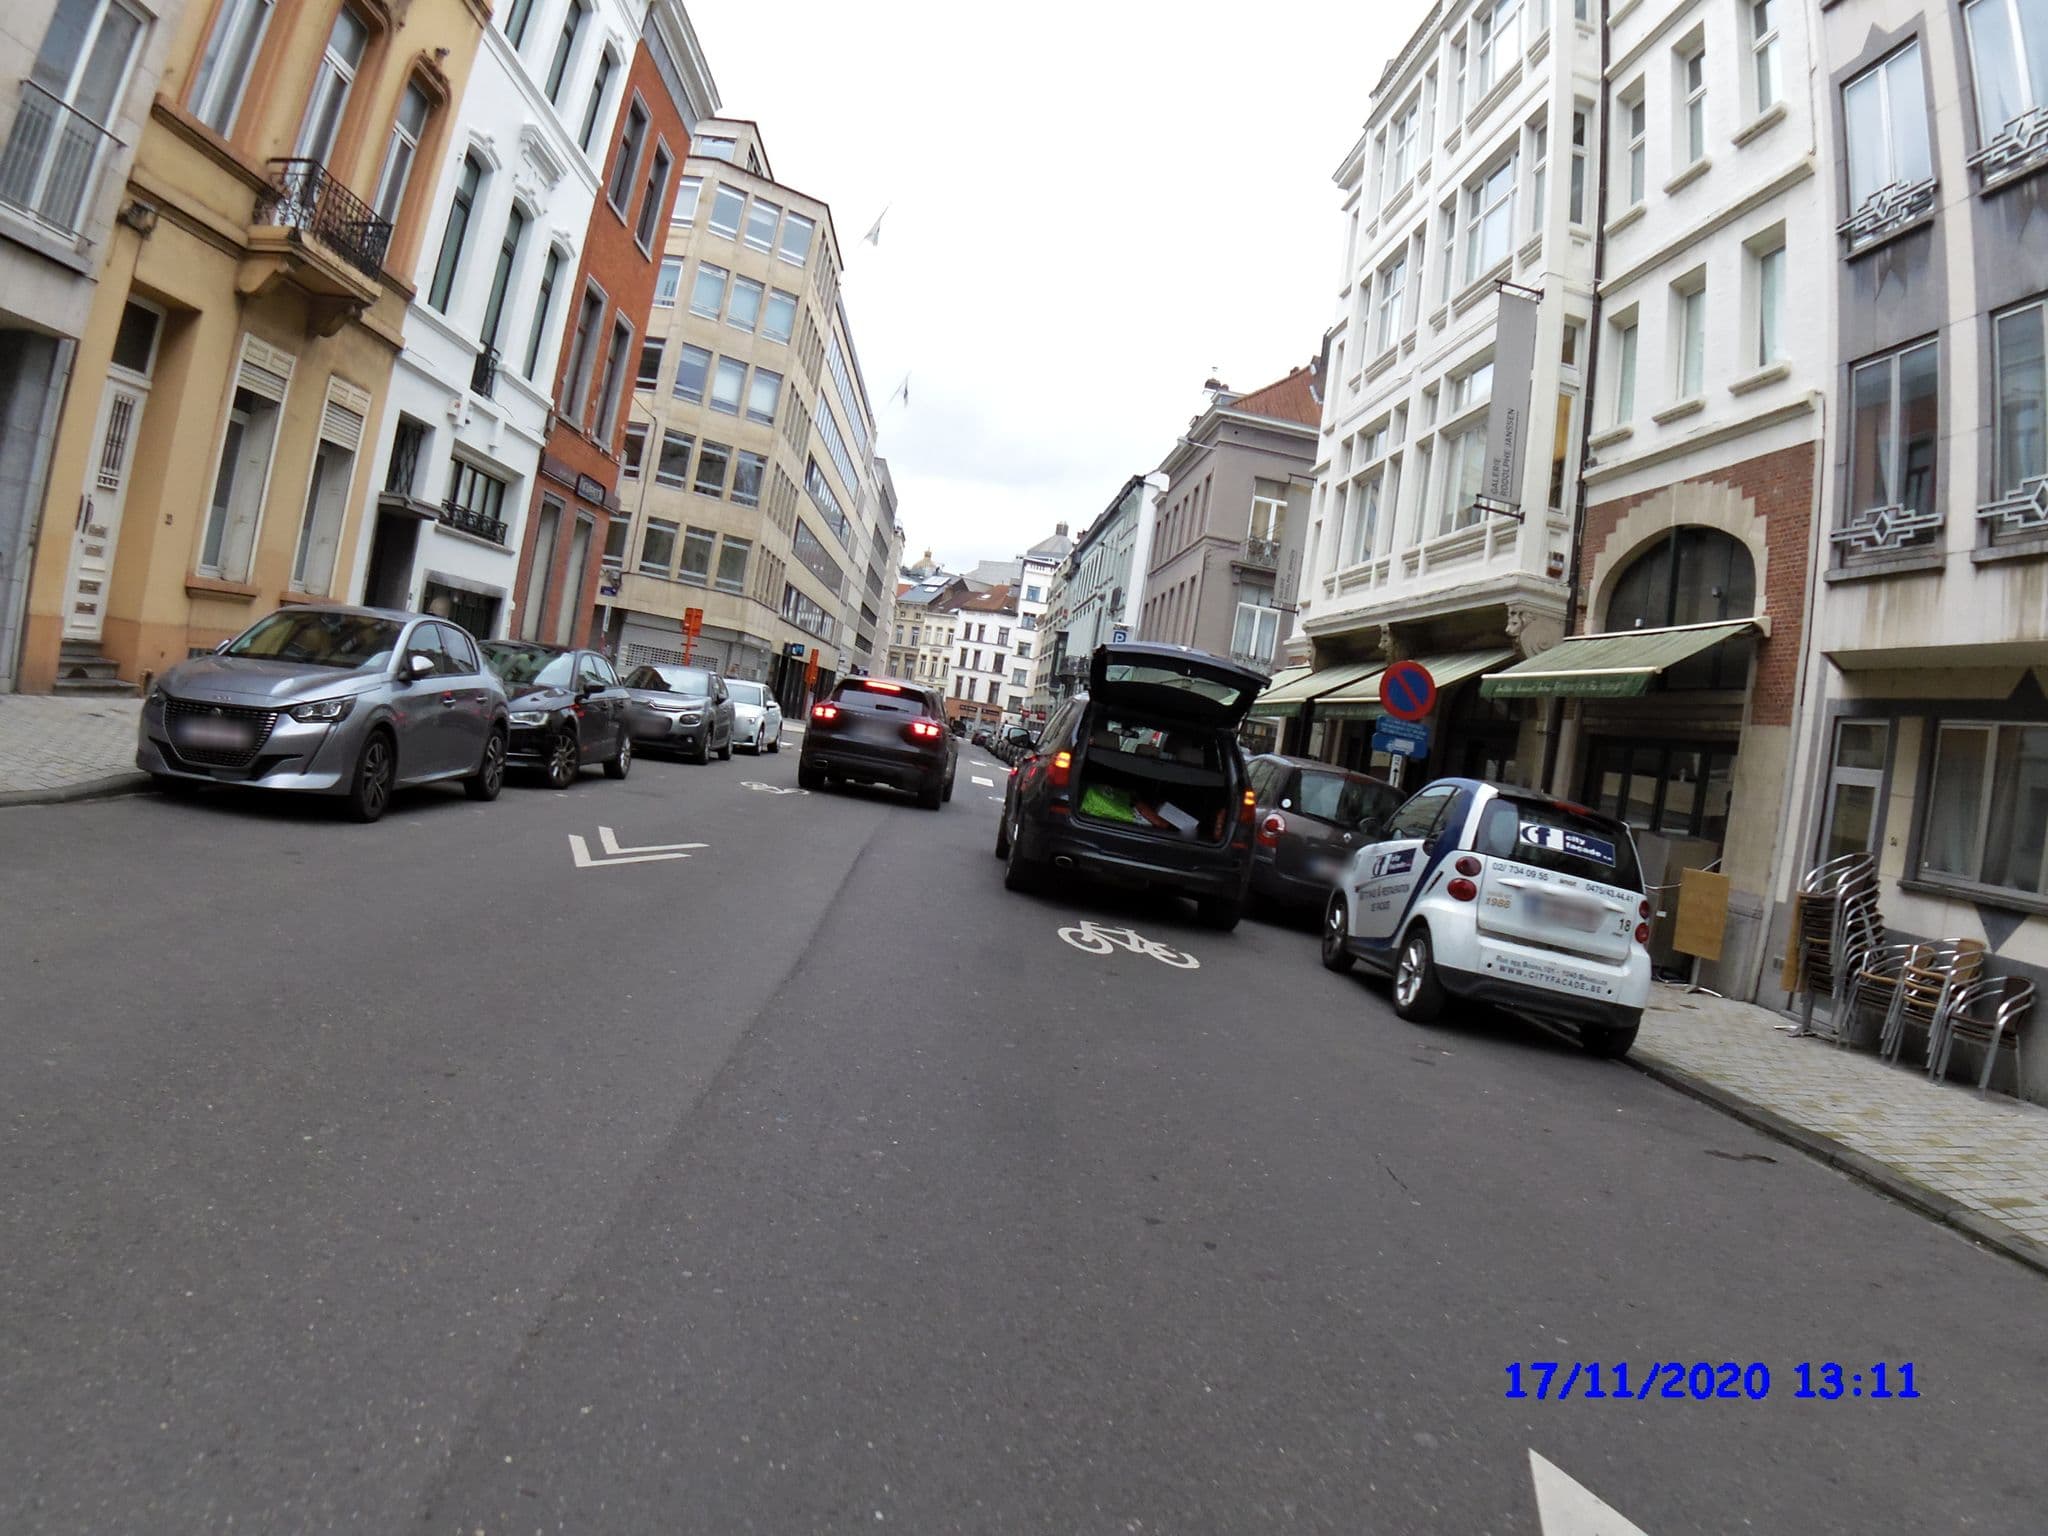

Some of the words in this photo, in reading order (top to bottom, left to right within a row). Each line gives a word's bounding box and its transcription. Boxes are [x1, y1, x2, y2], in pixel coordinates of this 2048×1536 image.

[1504, 408, 1516, 448] JANSSEN
[1490, 457, 1501, 495] GALERIE
[1500, 450, 1512, 497] RODOLPHE
[1566, 835, 1586, 846] city
[1509, 865, 1524, 875] 734
[1526, 869, 1536, 878] 09
[1619, 918, 1632, 932] 18
